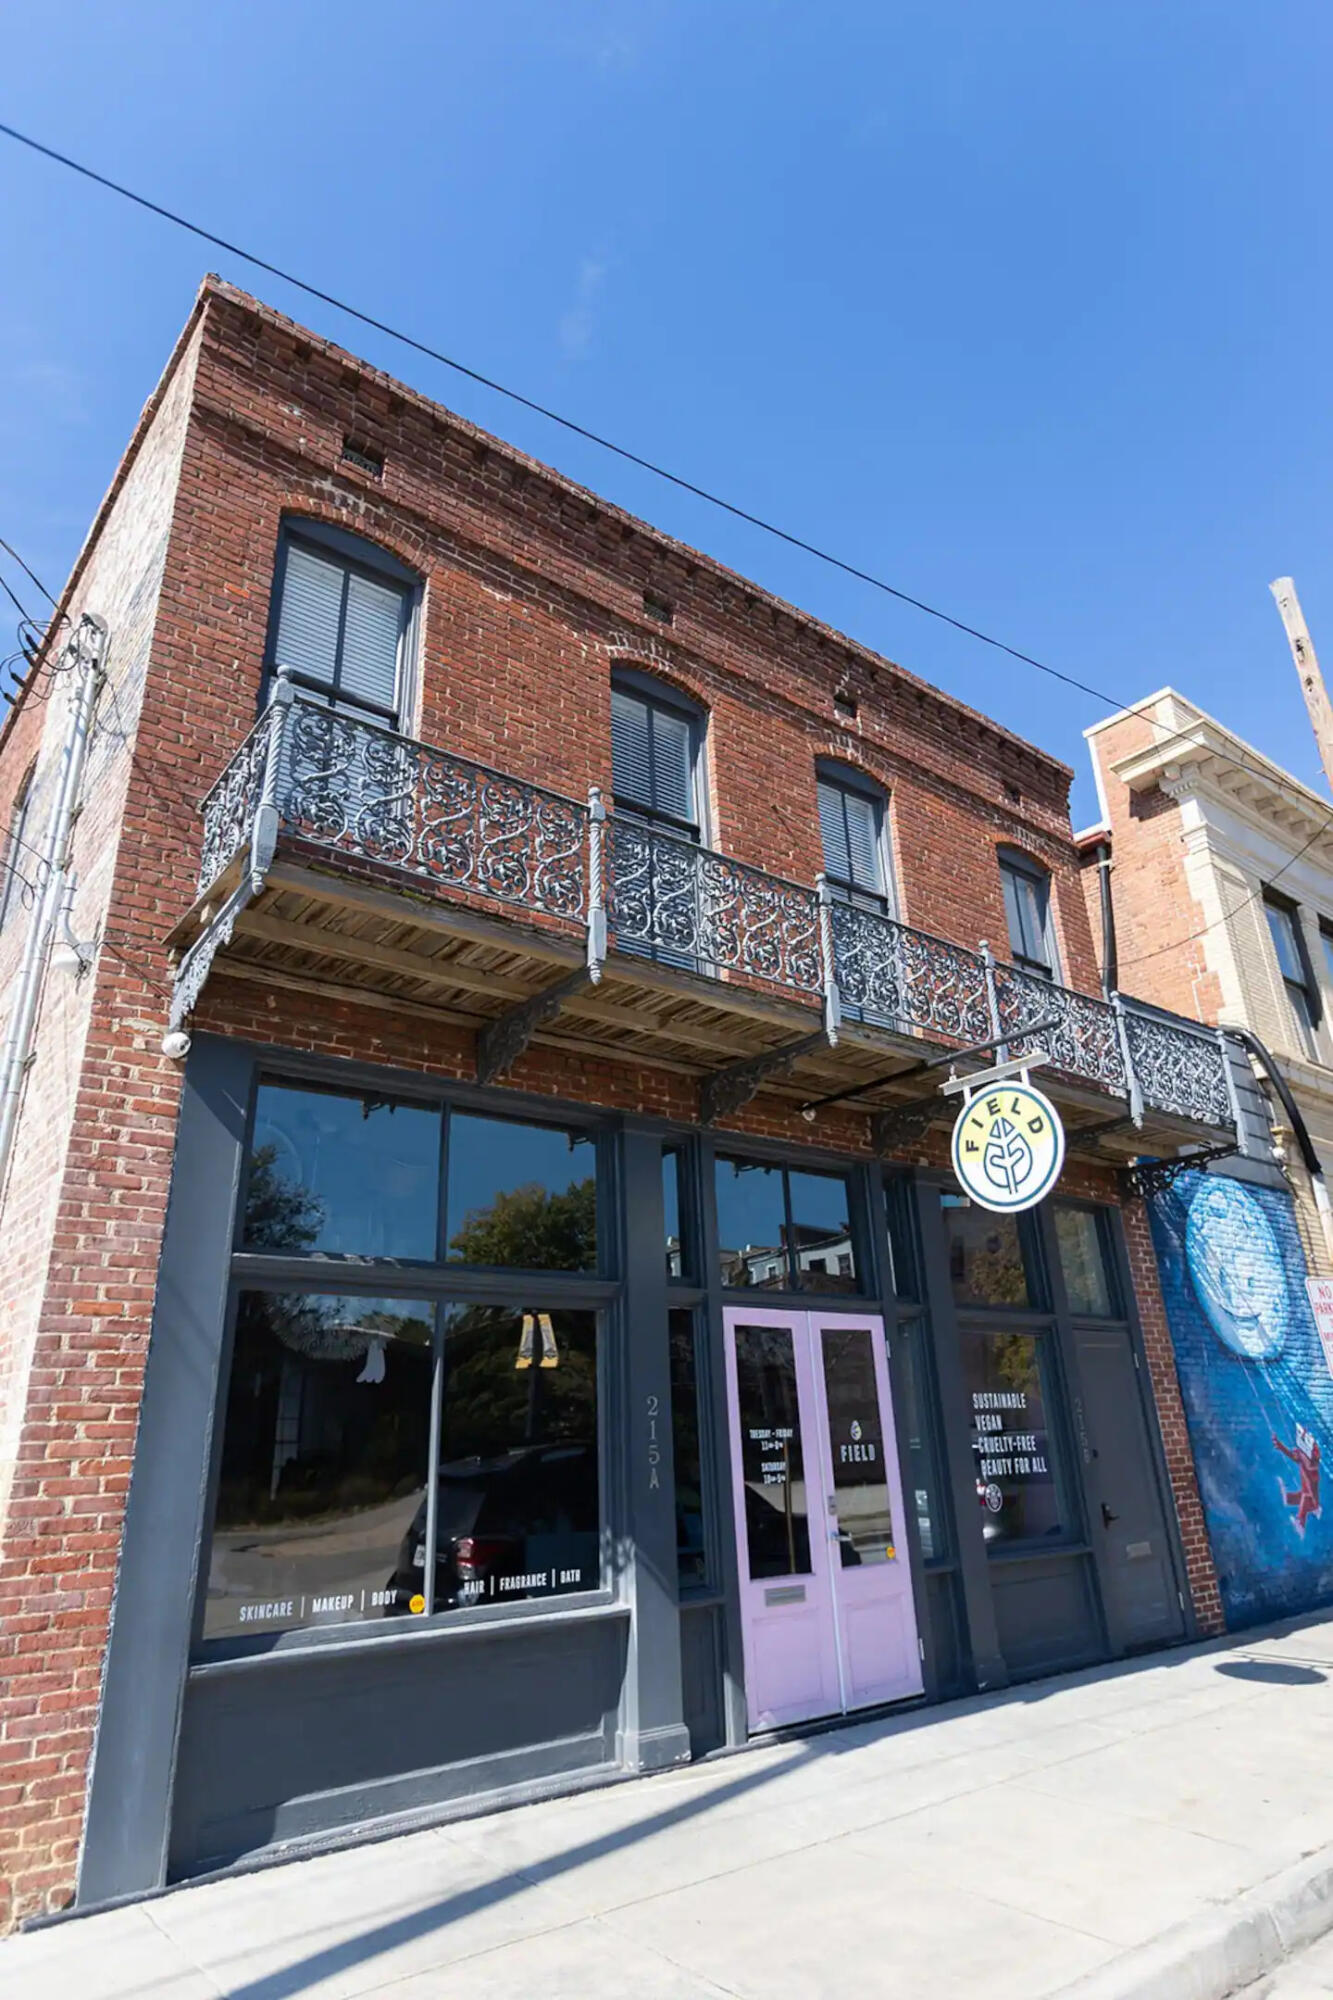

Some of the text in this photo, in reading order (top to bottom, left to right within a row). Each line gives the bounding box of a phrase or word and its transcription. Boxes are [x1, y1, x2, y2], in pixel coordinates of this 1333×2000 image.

[965, 1097, 1044, 1152] FIELD
[1318, 1286, 1332, 1299] NO
[972, 1392, 1027, 1409] SUSTAINABLE
[975, 1414, 1003, 1431] VEGAN
[646, 1395, 660, 1489] 215A
[977, 1435, 1037, 1453] CRUELTY-FREE
[840, 1444, 876, 1462] FIELD
[980, 1456, 1047, 1475] BEAUTY FOR ALL
[463, 1569, 580, 1595] HAIR FRAGRANCE BATH
[239, 1601, 293, 1622] SKINCARE
[312, 1594, 354, 1613] MAKEUP
[371, 1589, 398, 1606] BODY
